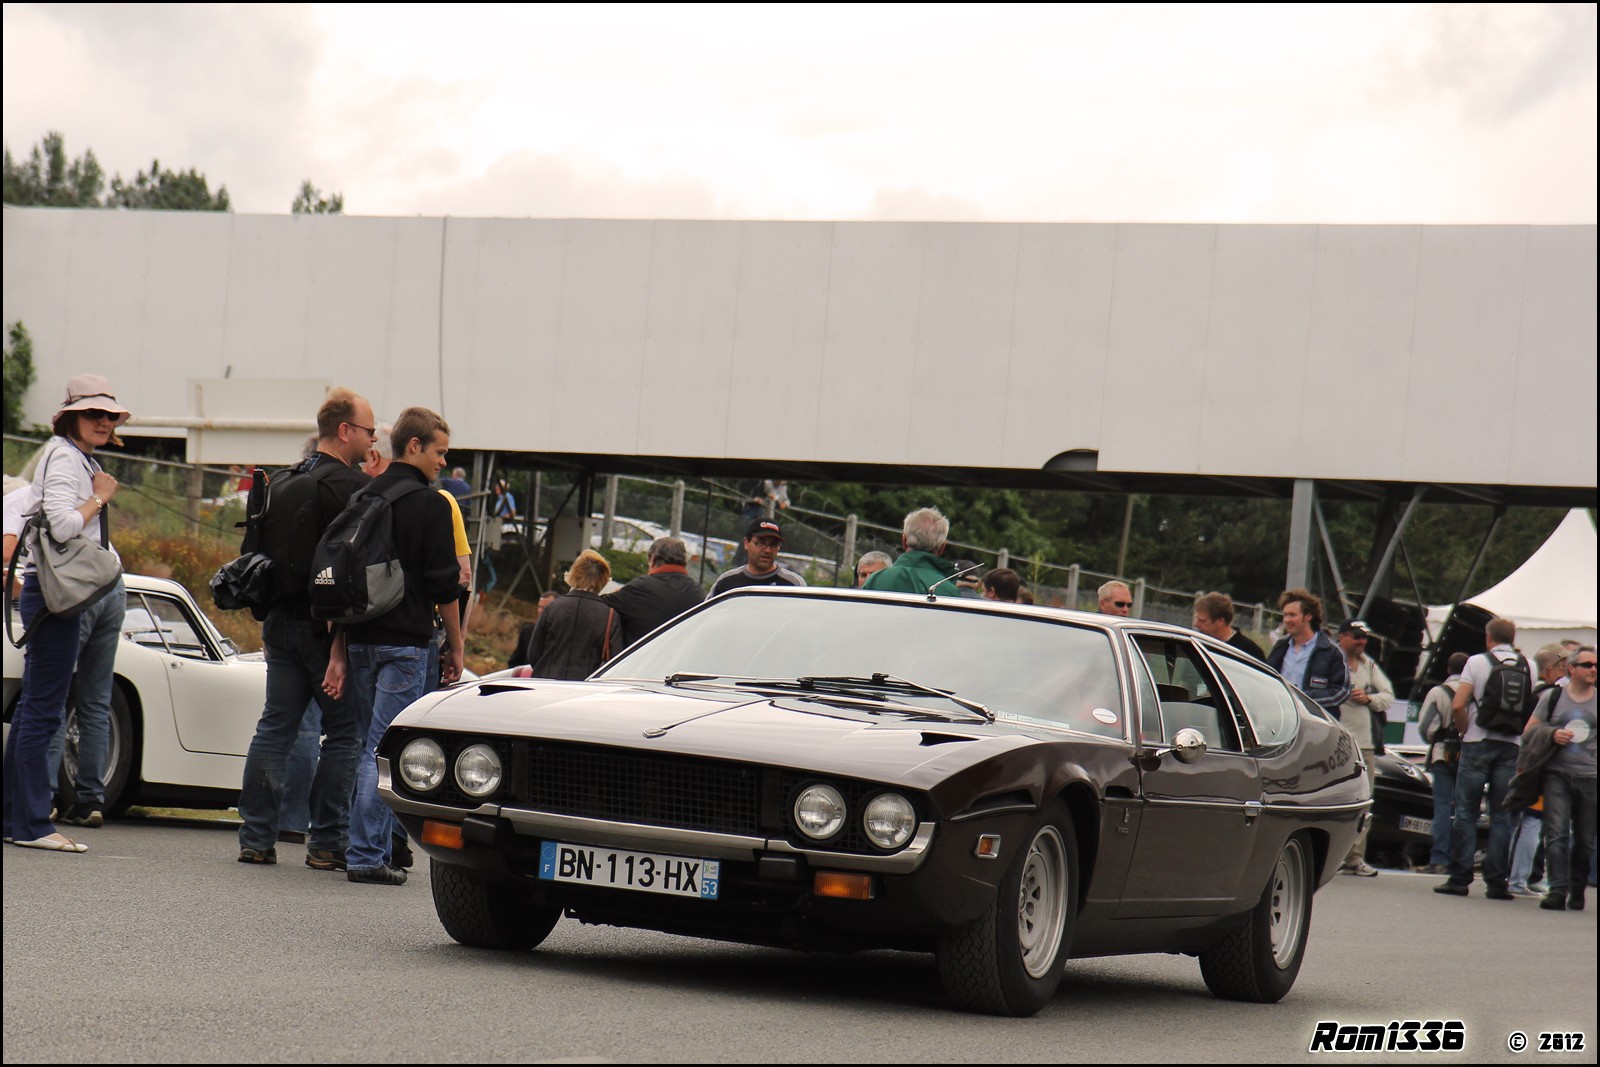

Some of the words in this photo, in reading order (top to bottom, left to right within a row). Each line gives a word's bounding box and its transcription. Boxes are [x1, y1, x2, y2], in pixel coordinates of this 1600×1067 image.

[314, 577, 336, 585] adidas
[544, 864, 550, 873] F
[558, 847, 700, 893] BN-113-HX
[702, 880, 718, 896] 53
